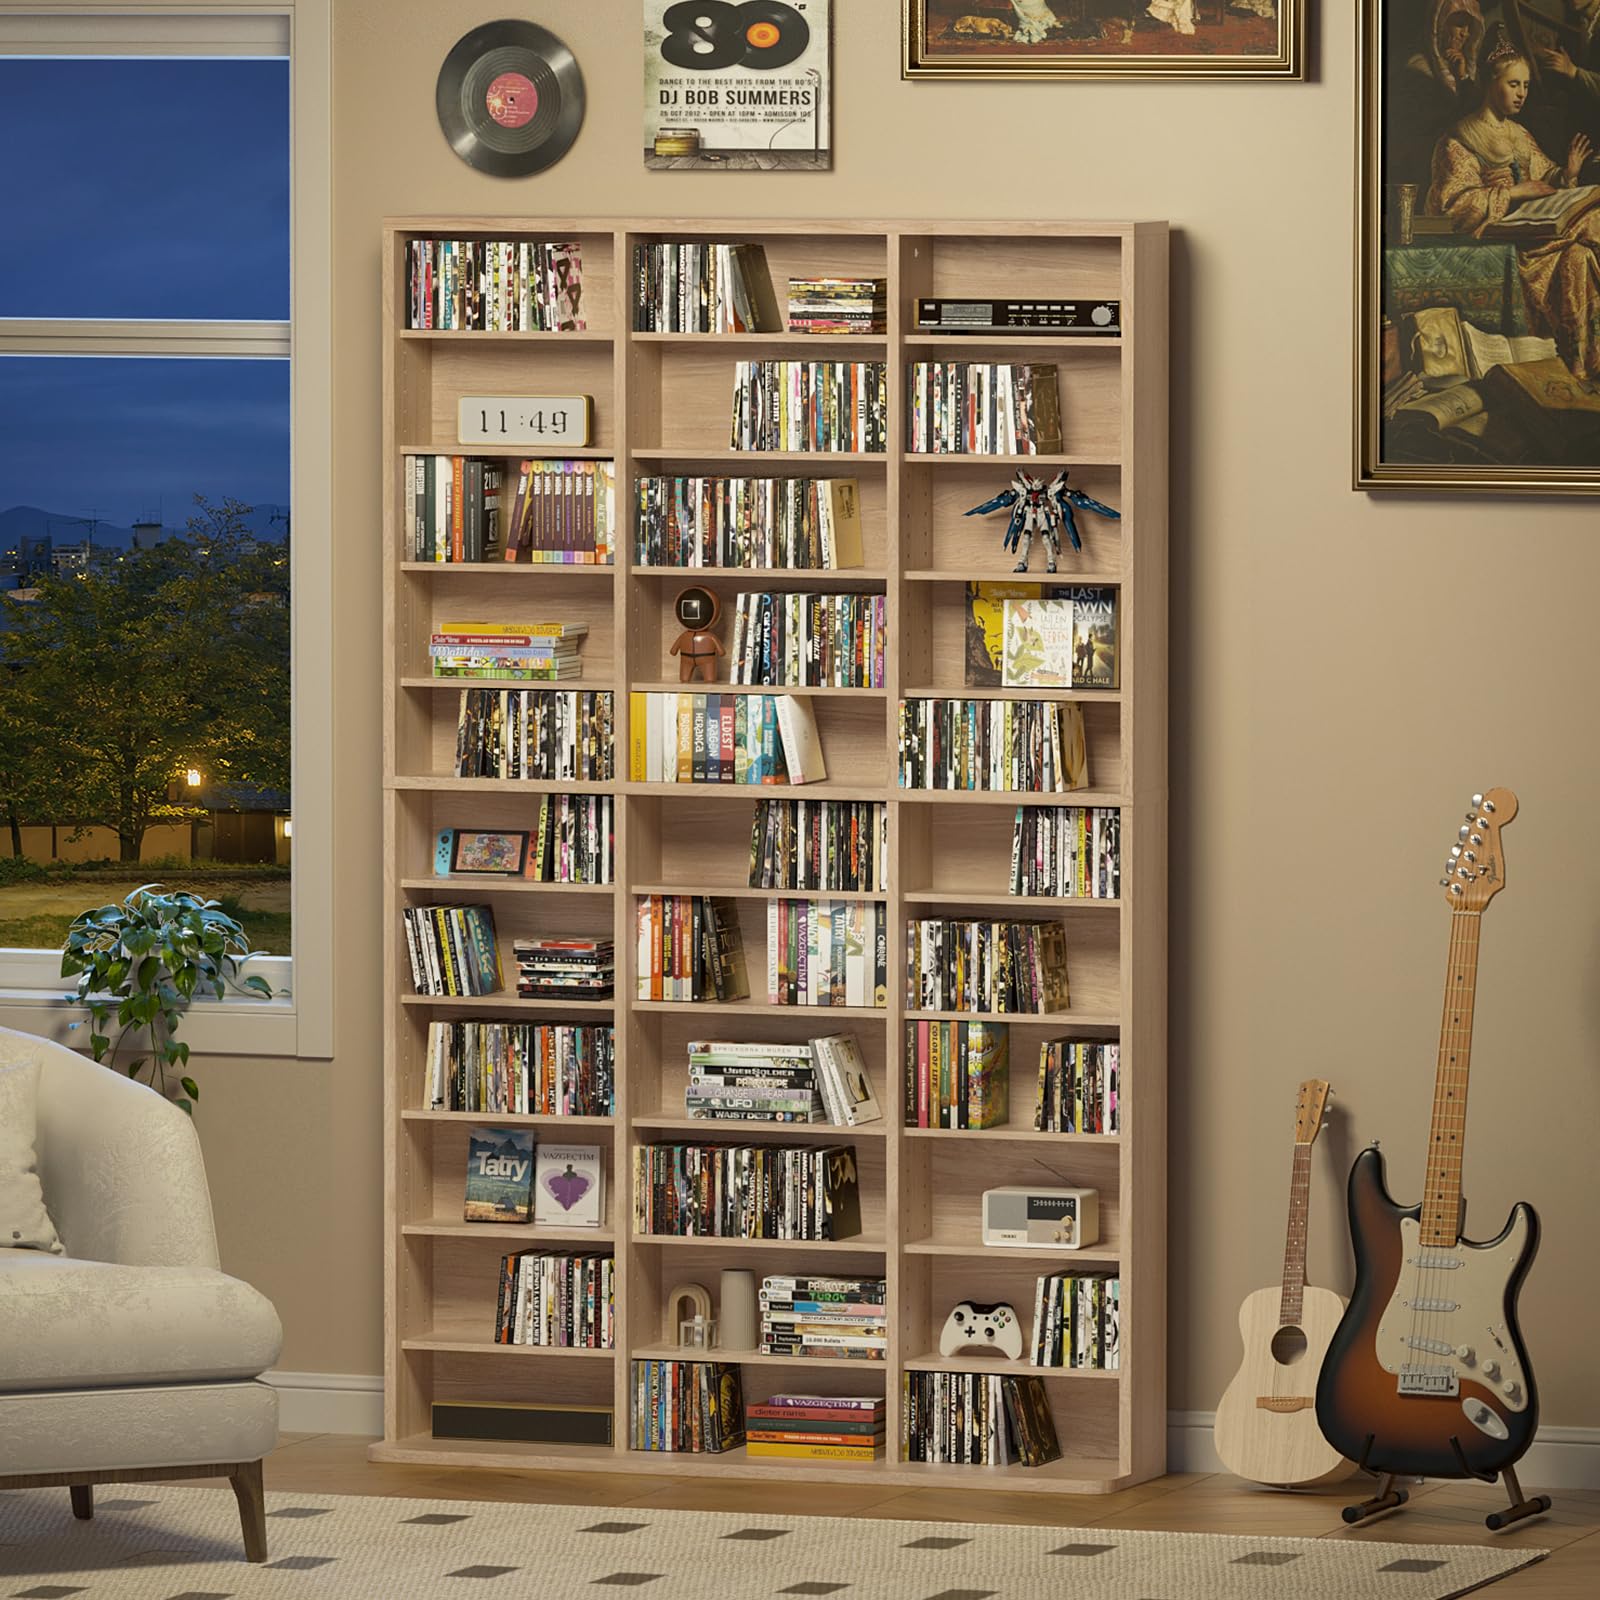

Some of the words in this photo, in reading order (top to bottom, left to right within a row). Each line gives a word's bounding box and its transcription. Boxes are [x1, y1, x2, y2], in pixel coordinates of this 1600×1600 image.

[660, 90, 677, 105] DJ
[685, 90, 718, 105] BOB
[726, 90, 811, 105] SUMMERS
[679, 274, 686, 282] A
[679, 282, 686, 294] OF
[480, 409, 568, 434] 11:49
[1070, 587, 1104, 599] LAST
[1072, 601, 1112, 615] AWN
[1072, 615, 1108, 623] OCALYPSE
[433, 646, 484, 657] Matilda
[721, 715, 733, 751] ELDEST
[834, 913, 845, 941] TATRY
[932, 1055, 938, 1068] OF
[714, 1089, 749, 1098] CHANGE
[726, 1098, 753, 1108] UFO
[714, 1111, 746, 1119] WAIST
[475, 1151, 529, 1183] Tatry
[801, 1189, 808, 1201] OF
[950, 1405, 957, 1413] A
[950, 1413, 957, 1425] OF
